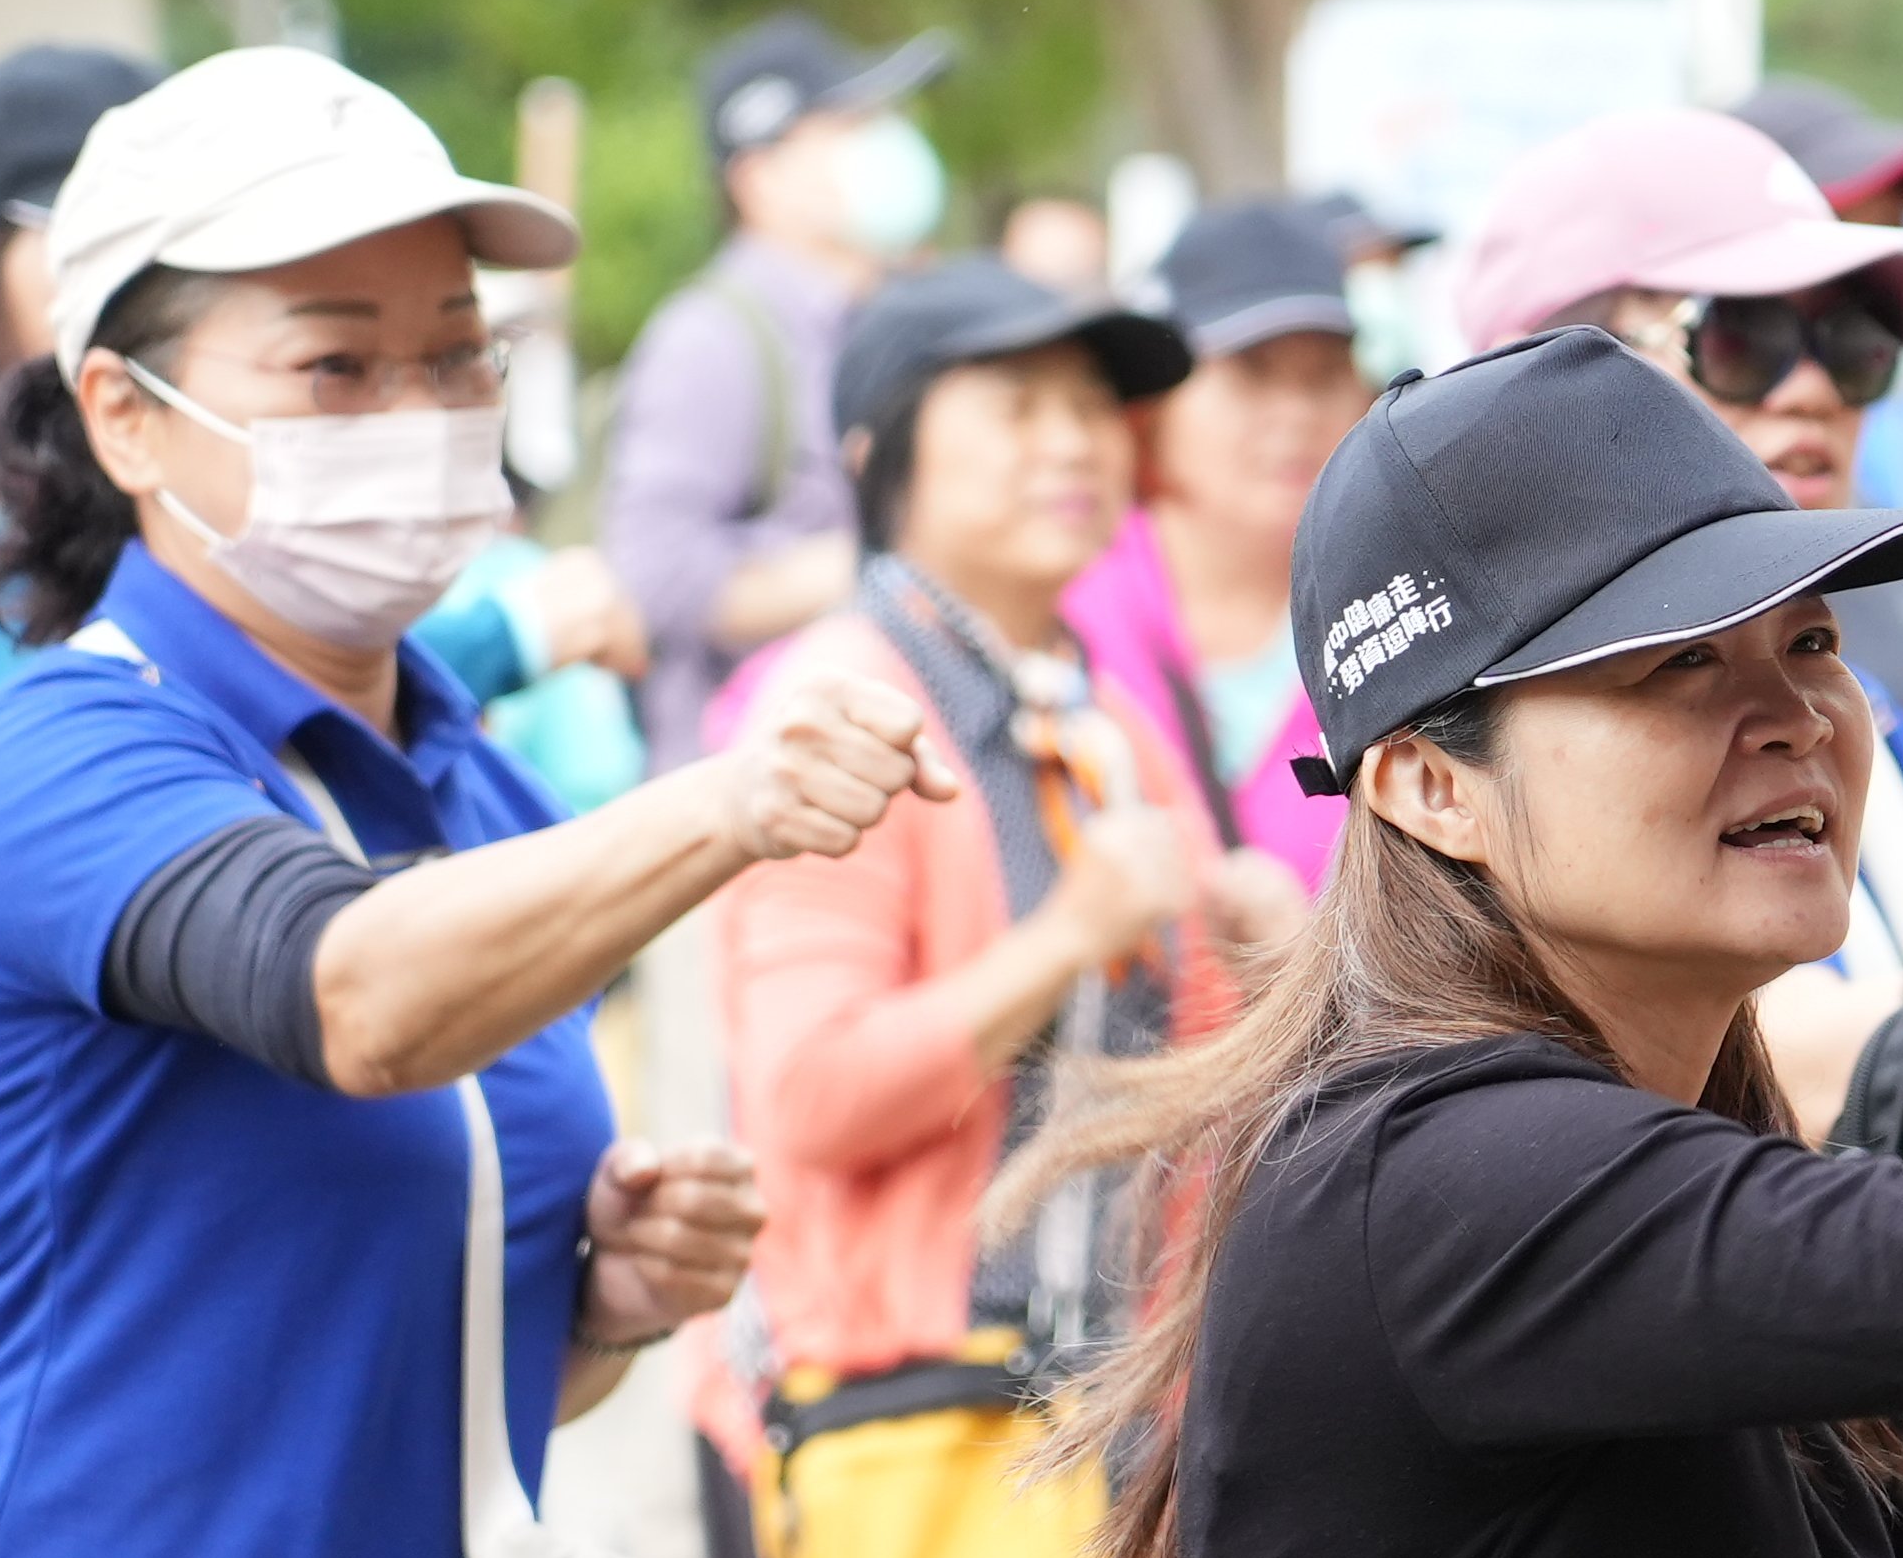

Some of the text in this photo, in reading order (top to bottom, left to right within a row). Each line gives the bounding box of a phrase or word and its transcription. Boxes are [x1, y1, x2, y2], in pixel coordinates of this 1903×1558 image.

[1337, 594, 1453, 696] 勞資逗陣行
